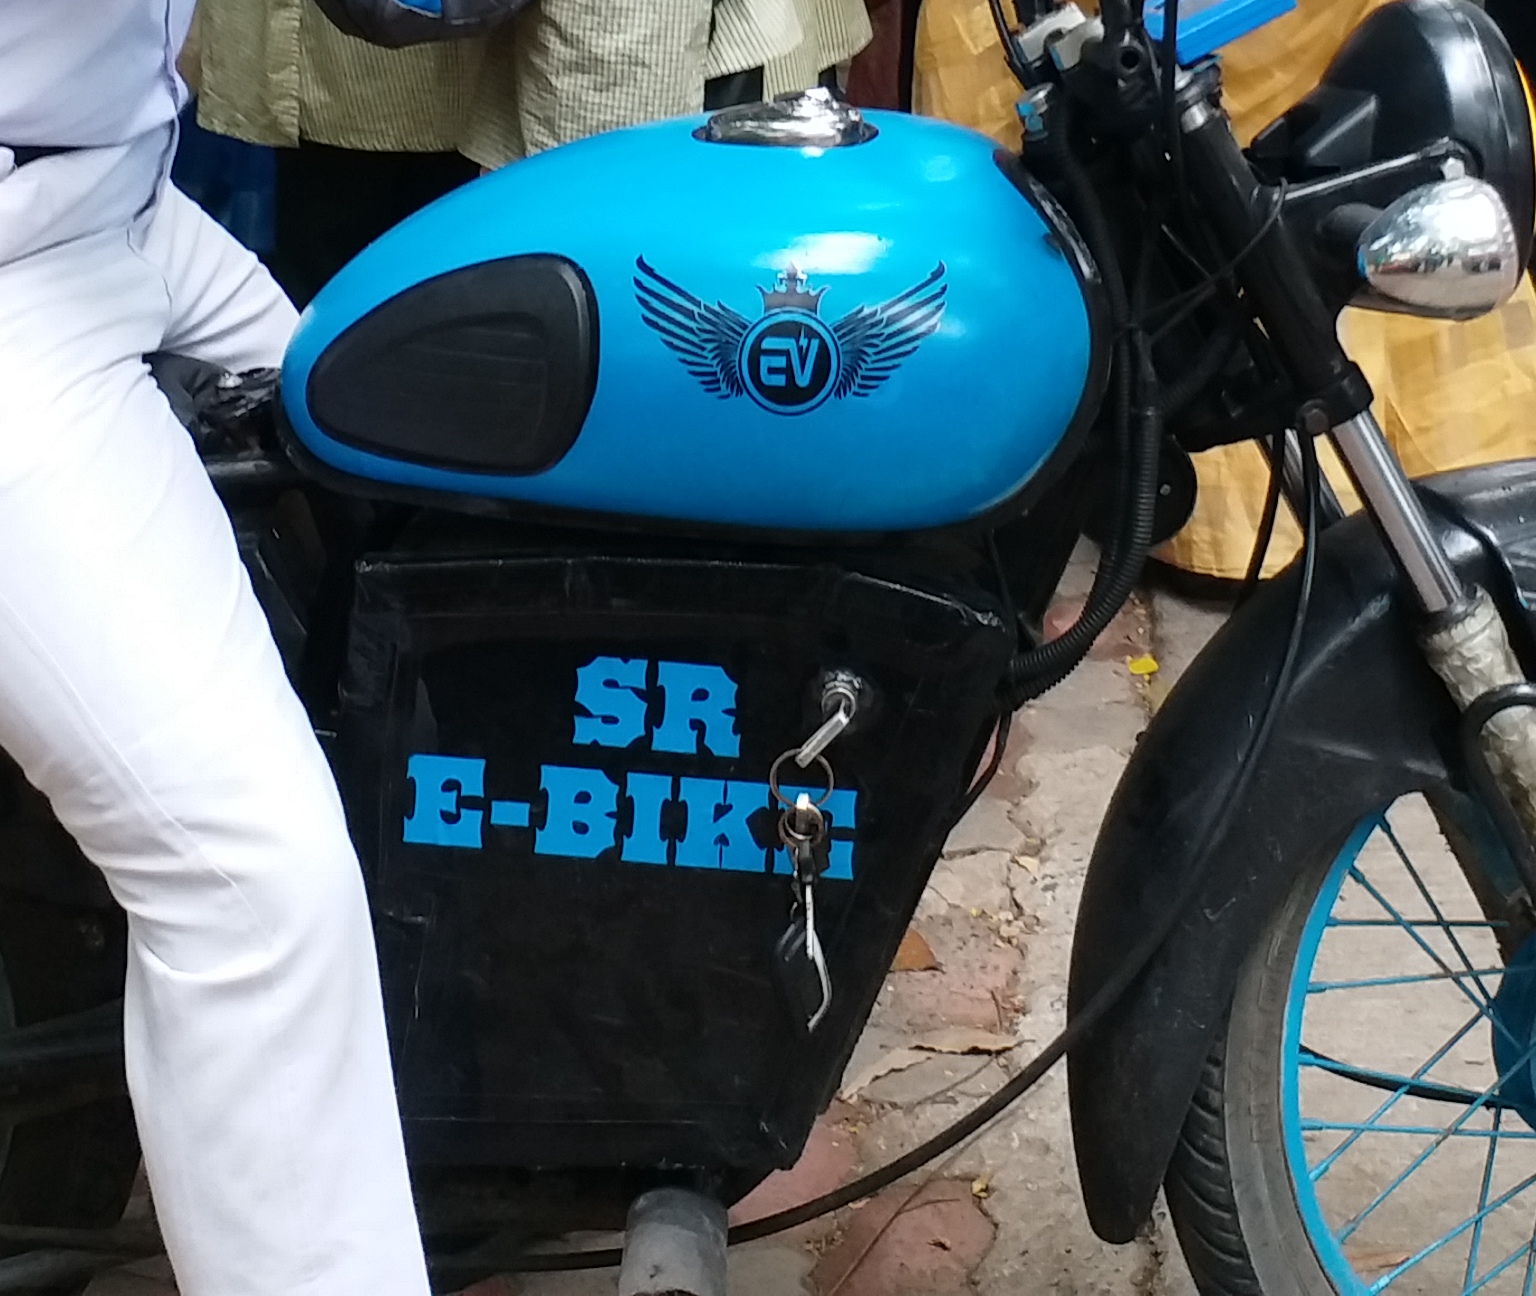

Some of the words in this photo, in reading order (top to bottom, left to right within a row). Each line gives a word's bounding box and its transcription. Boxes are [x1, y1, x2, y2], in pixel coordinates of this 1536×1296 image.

[758, 334, 820, 389] EV
[573, 656, 740, 758] SR
[403, 754, 858, 881] E-BIKE
